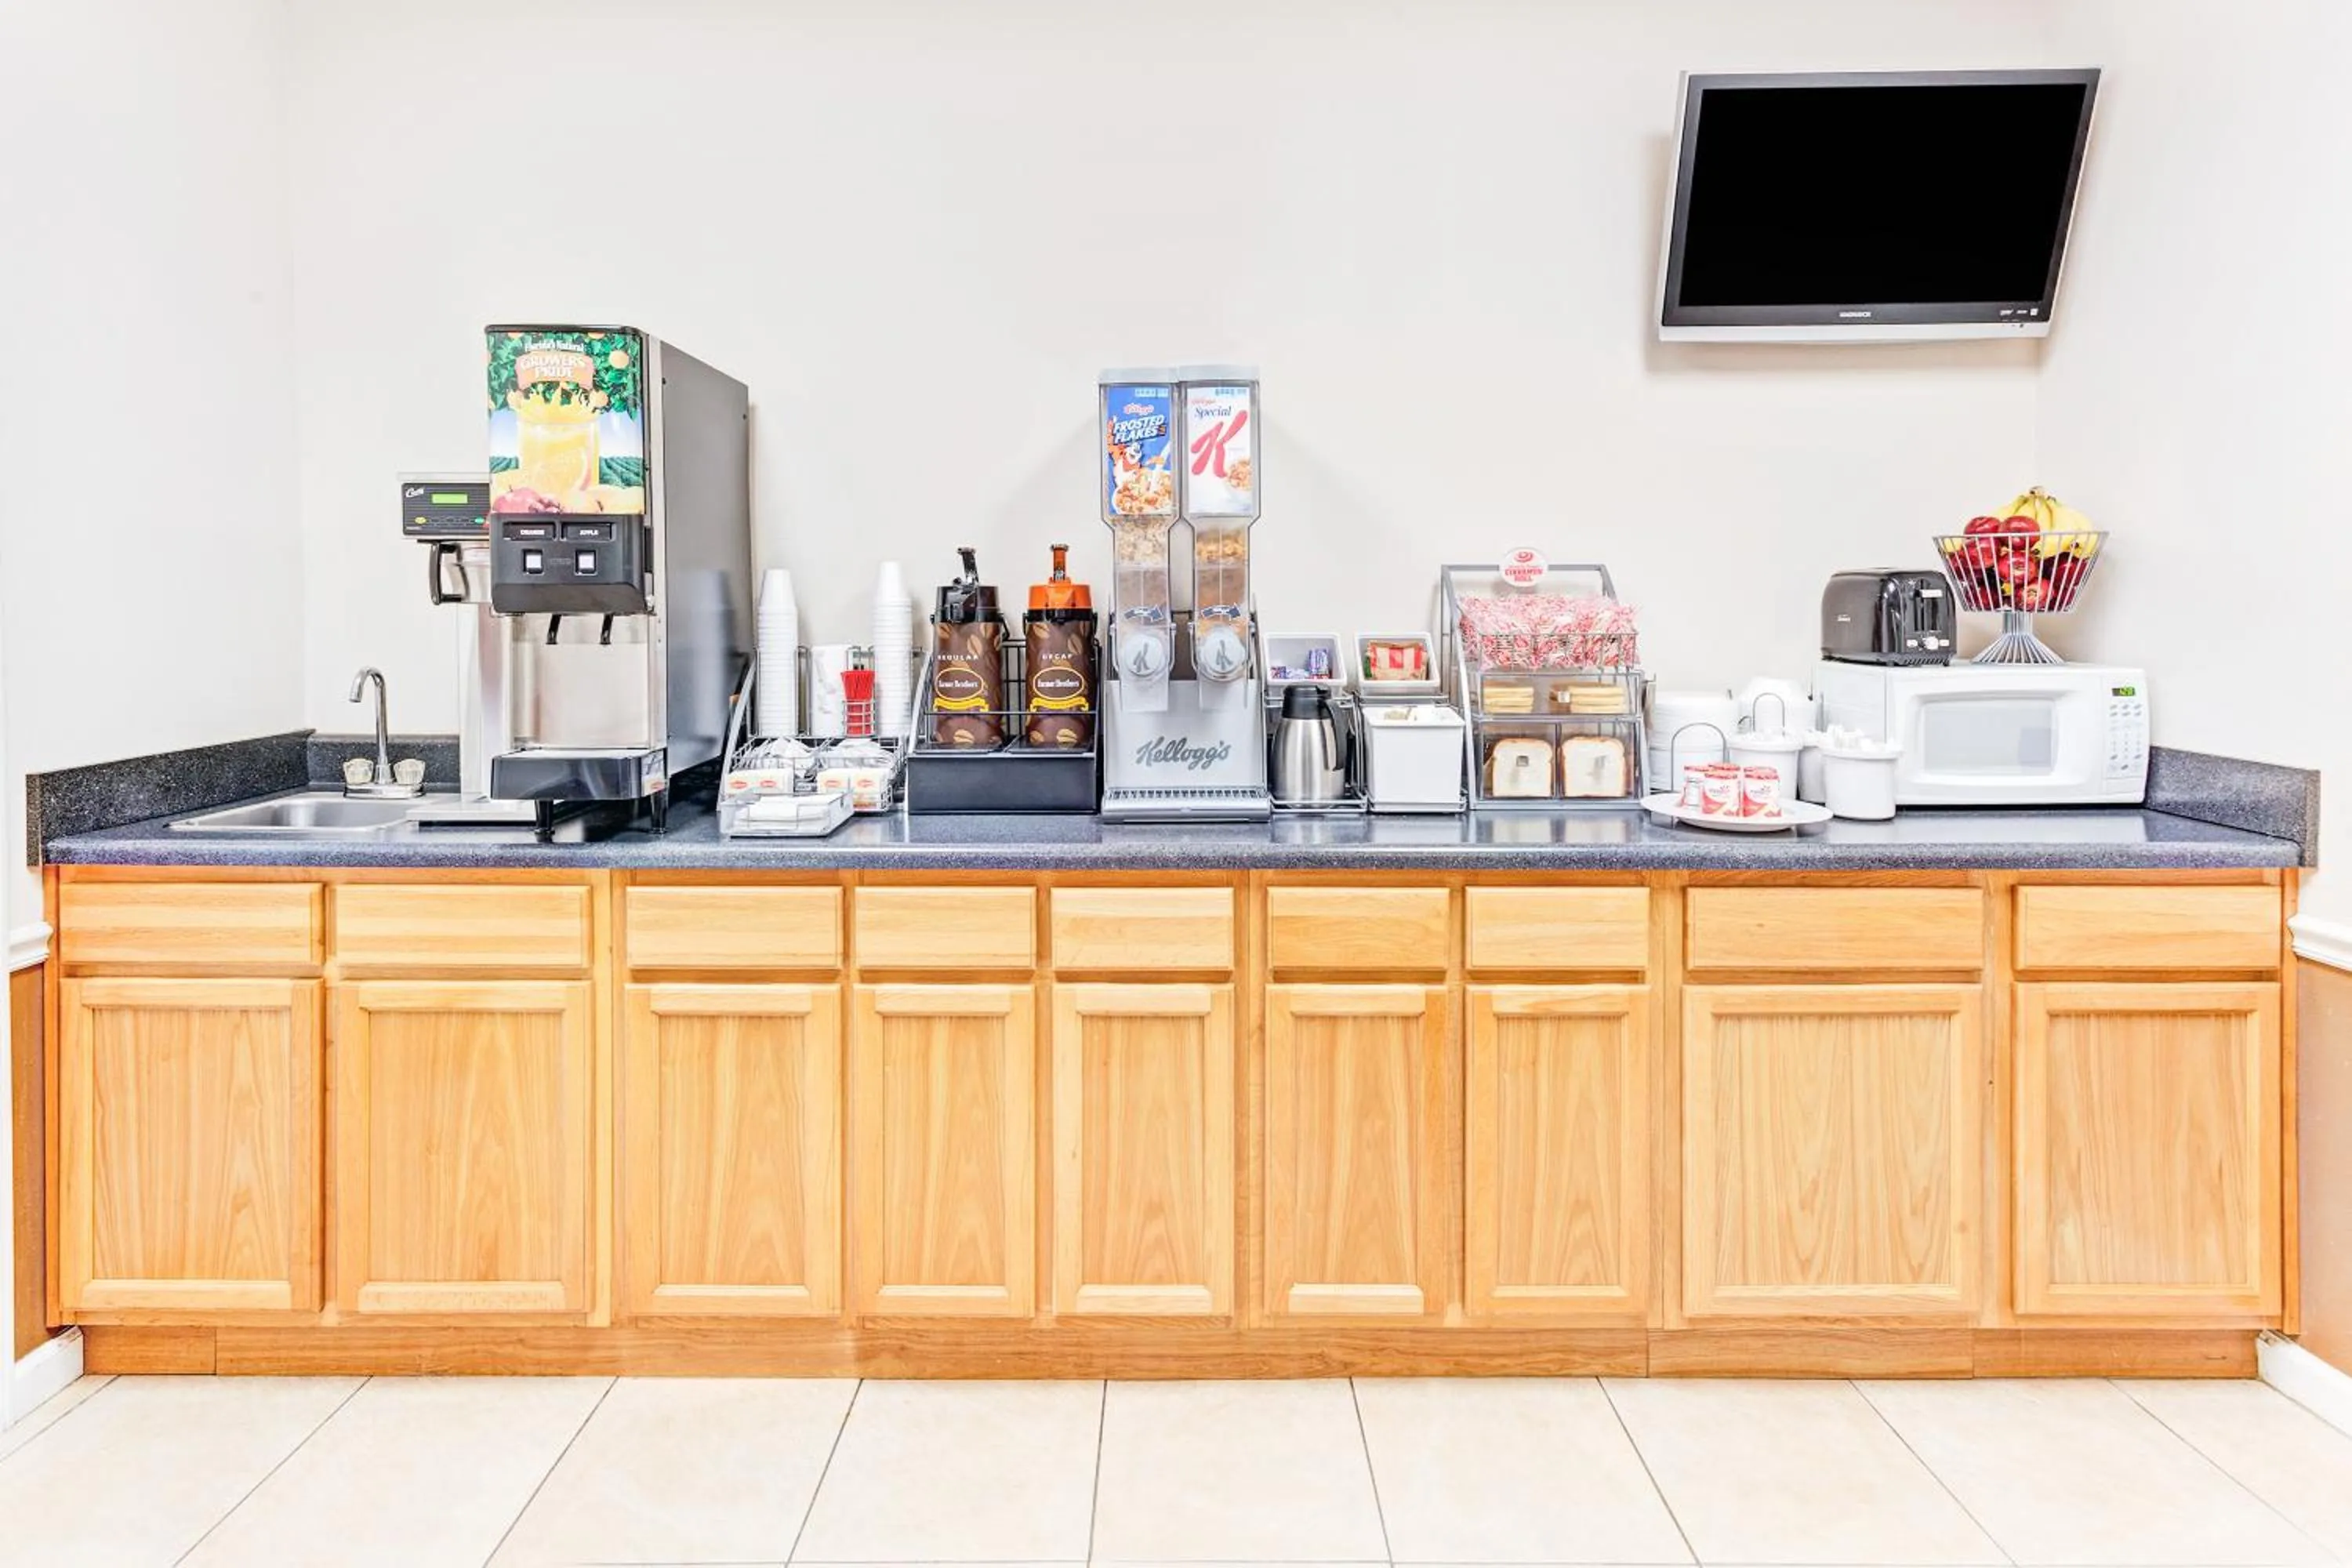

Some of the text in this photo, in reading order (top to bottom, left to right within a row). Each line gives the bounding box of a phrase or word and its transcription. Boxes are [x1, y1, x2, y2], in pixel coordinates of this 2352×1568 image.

[1194, 405, 1232, 419] Special
[1113, 414, 1165, 434] FROSTED
[1114, 425, 1159, 445] FLAKES
[1190, 409, 1247, 478] K
[1135, 735, 1231, 770] Kellogg's
